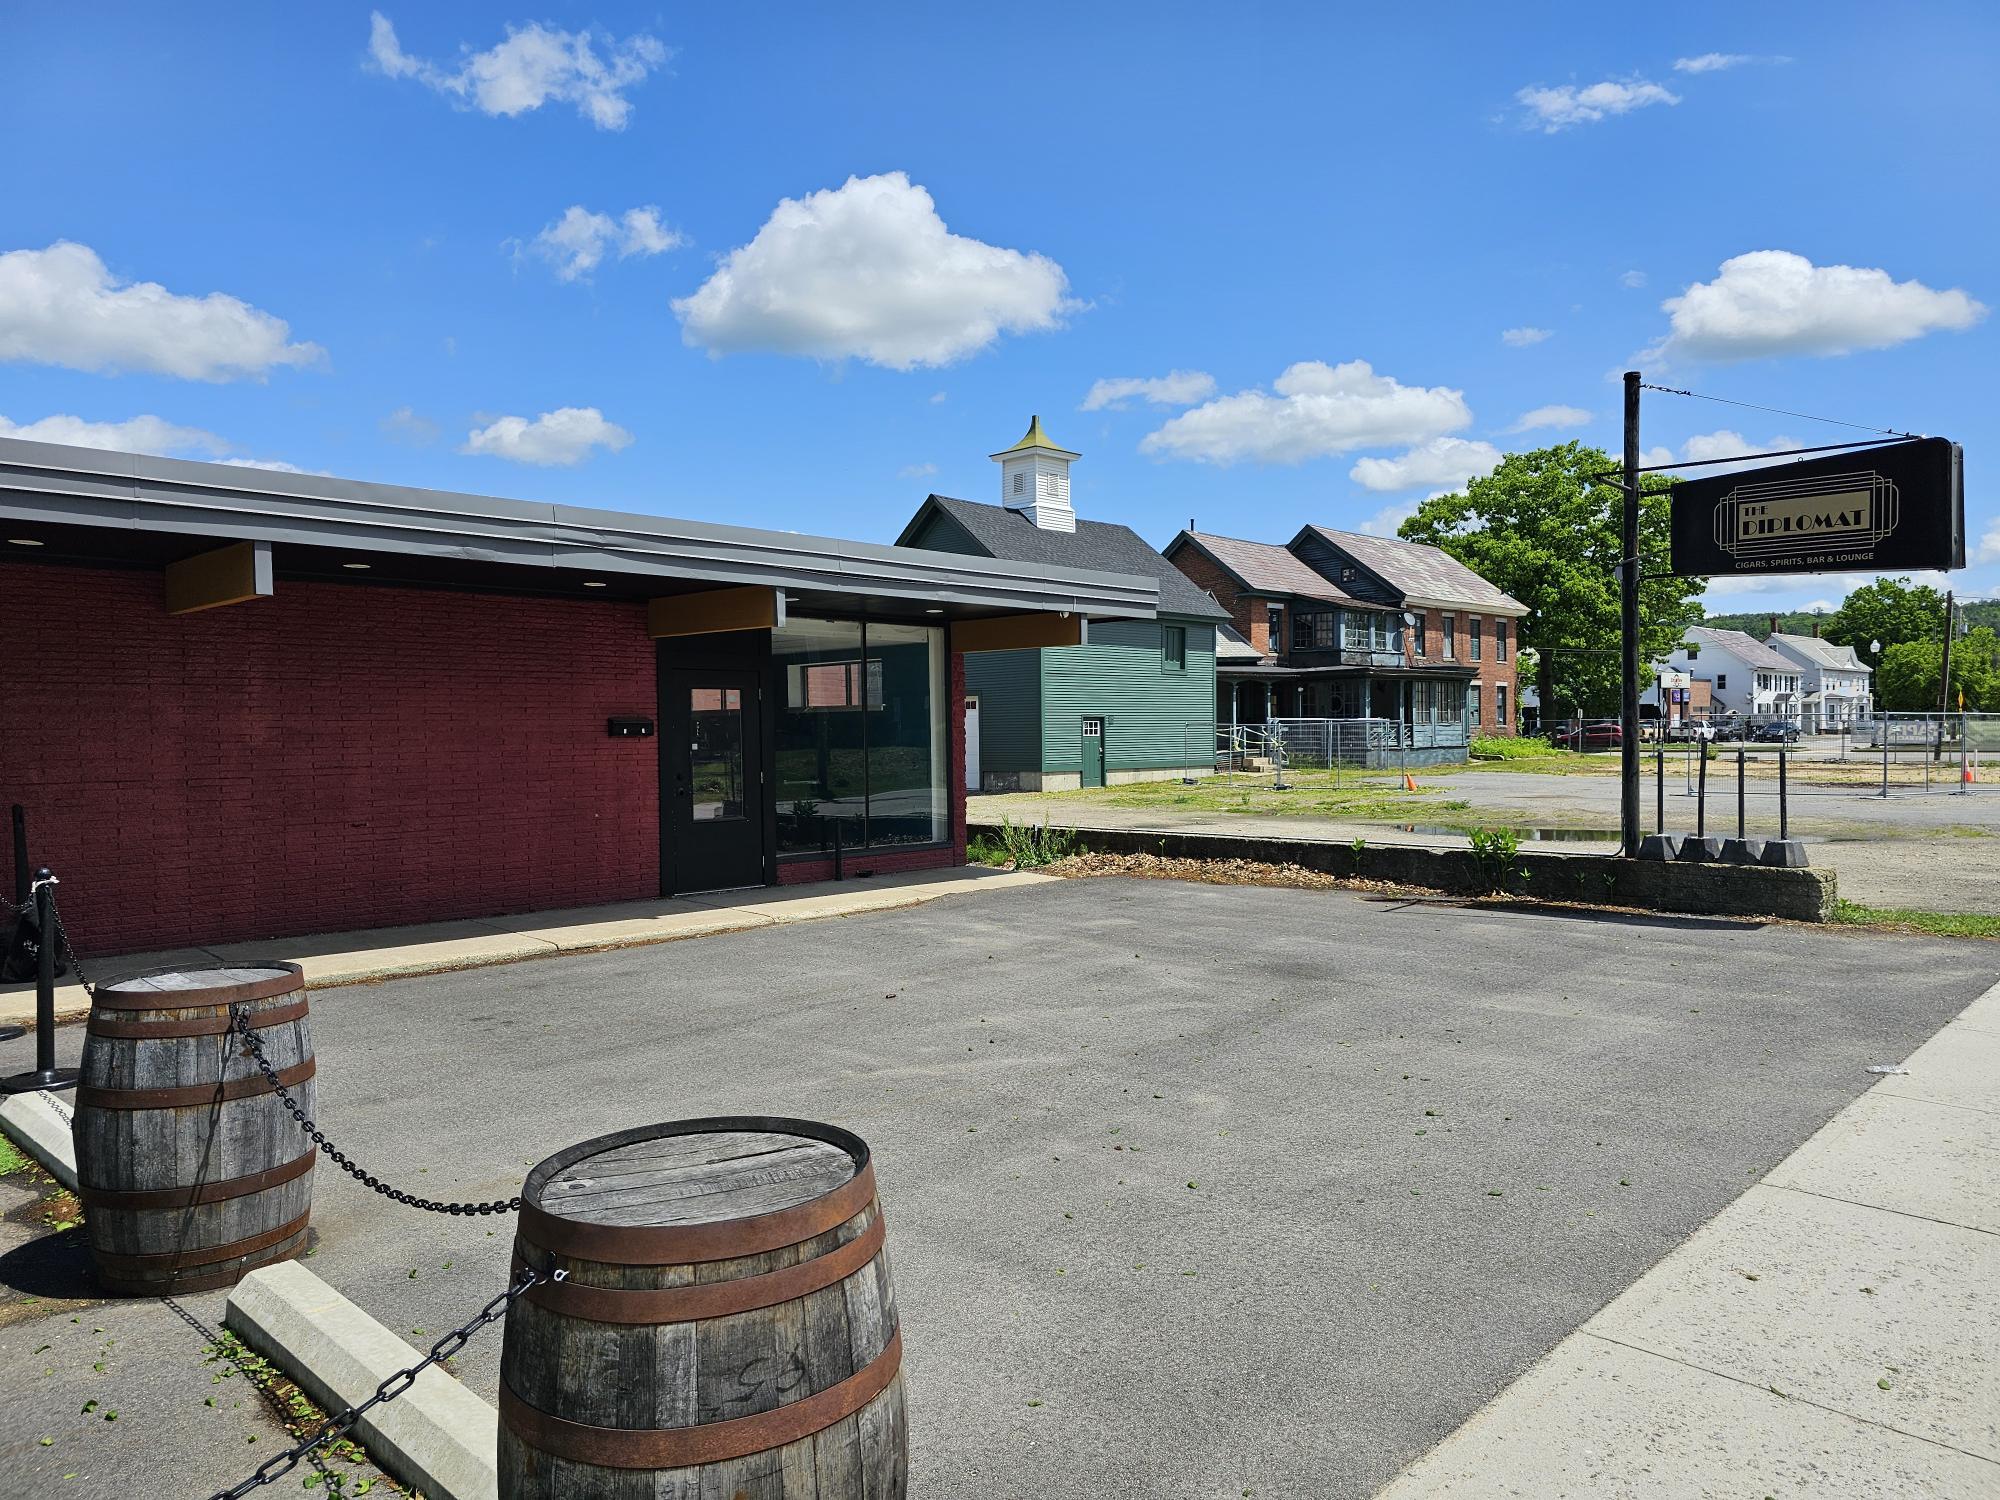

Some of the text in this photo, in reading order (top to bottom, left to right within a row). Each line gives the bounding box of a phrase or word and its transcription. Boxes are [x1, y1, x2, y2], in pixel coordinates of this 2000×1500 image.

[1743, 505, 1768, 517] THE
[1743, 509, 1866, 536] DIPLOMAT
[1735, 552, 1874, 569] CIGARS, SPIRITS, BAR & LOUNGE
